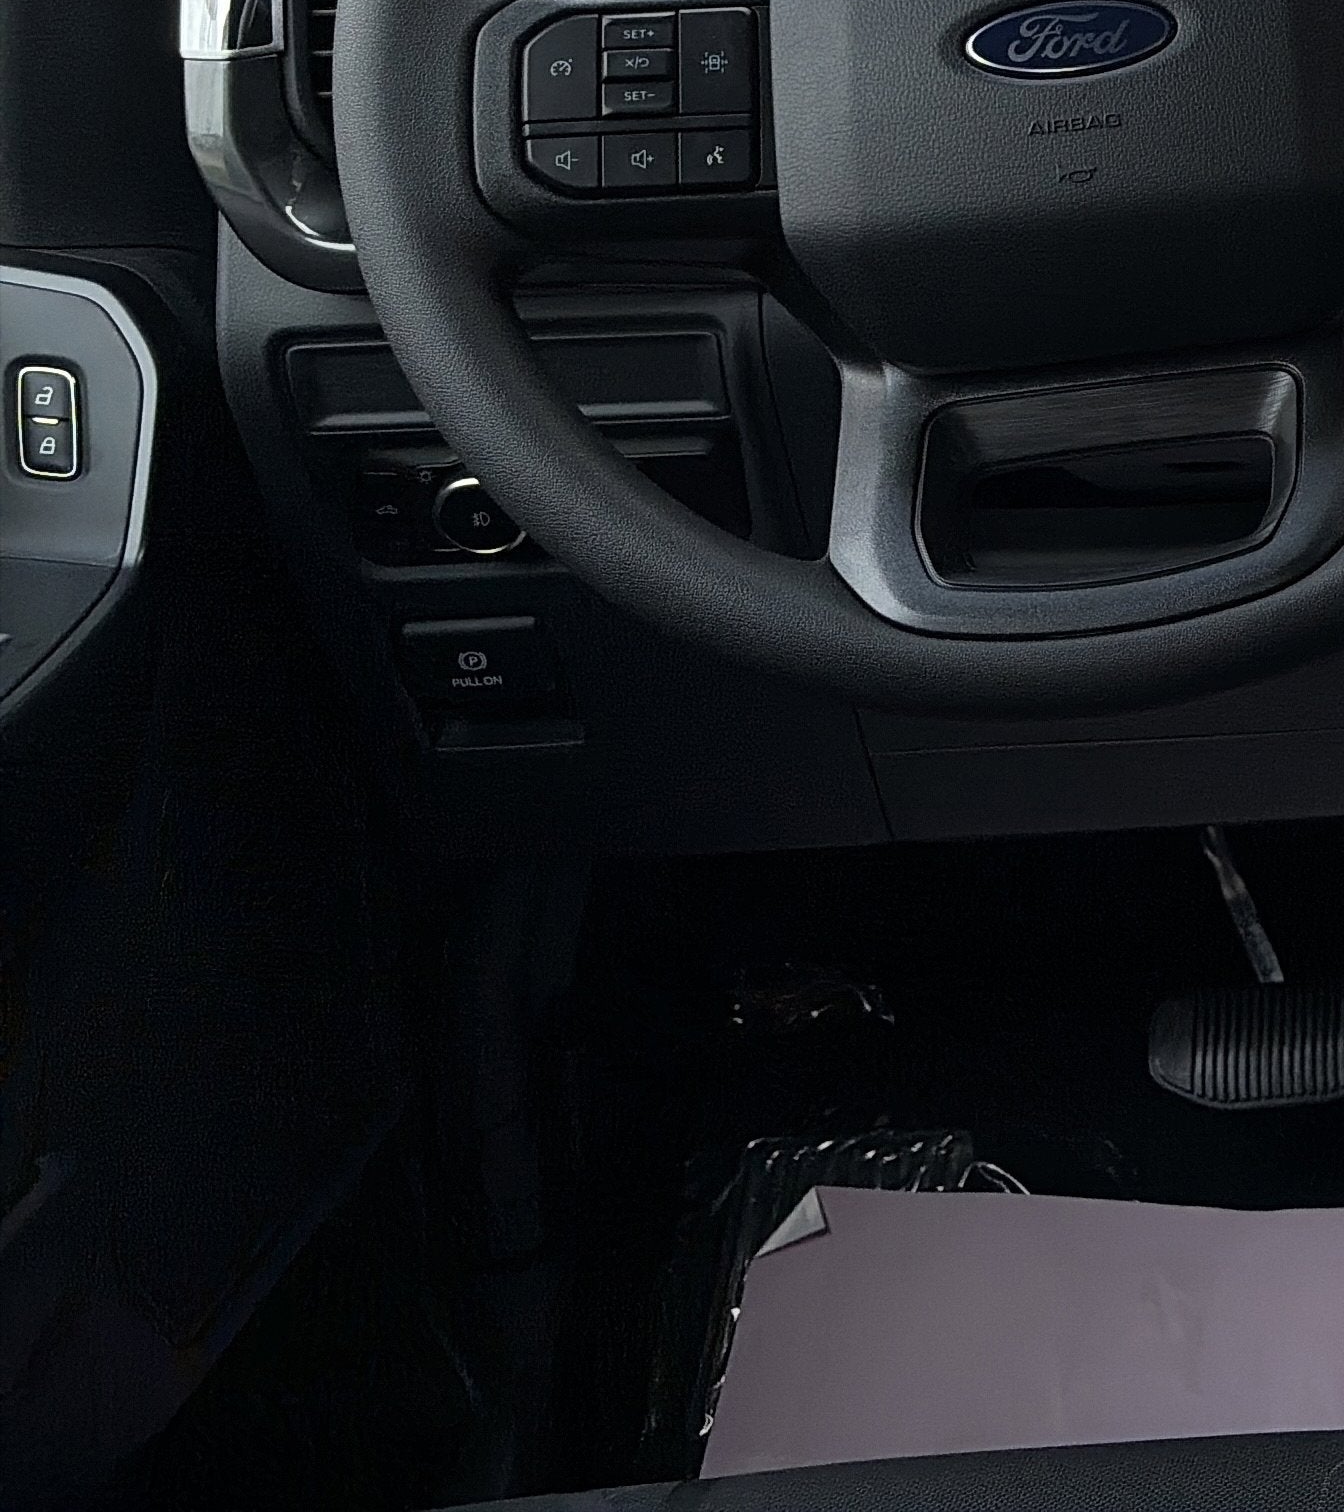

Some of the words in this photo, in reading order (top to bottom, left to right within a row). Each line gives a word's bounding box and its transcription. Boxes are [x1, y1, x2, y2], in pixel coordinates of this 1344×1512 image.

[1007, 11, 1130, 64] Ford
[1026, 111, 1122, 138] AIRBAG
[451, 675, 483, 688] PULL
[482, 674, 503, 686] ON
